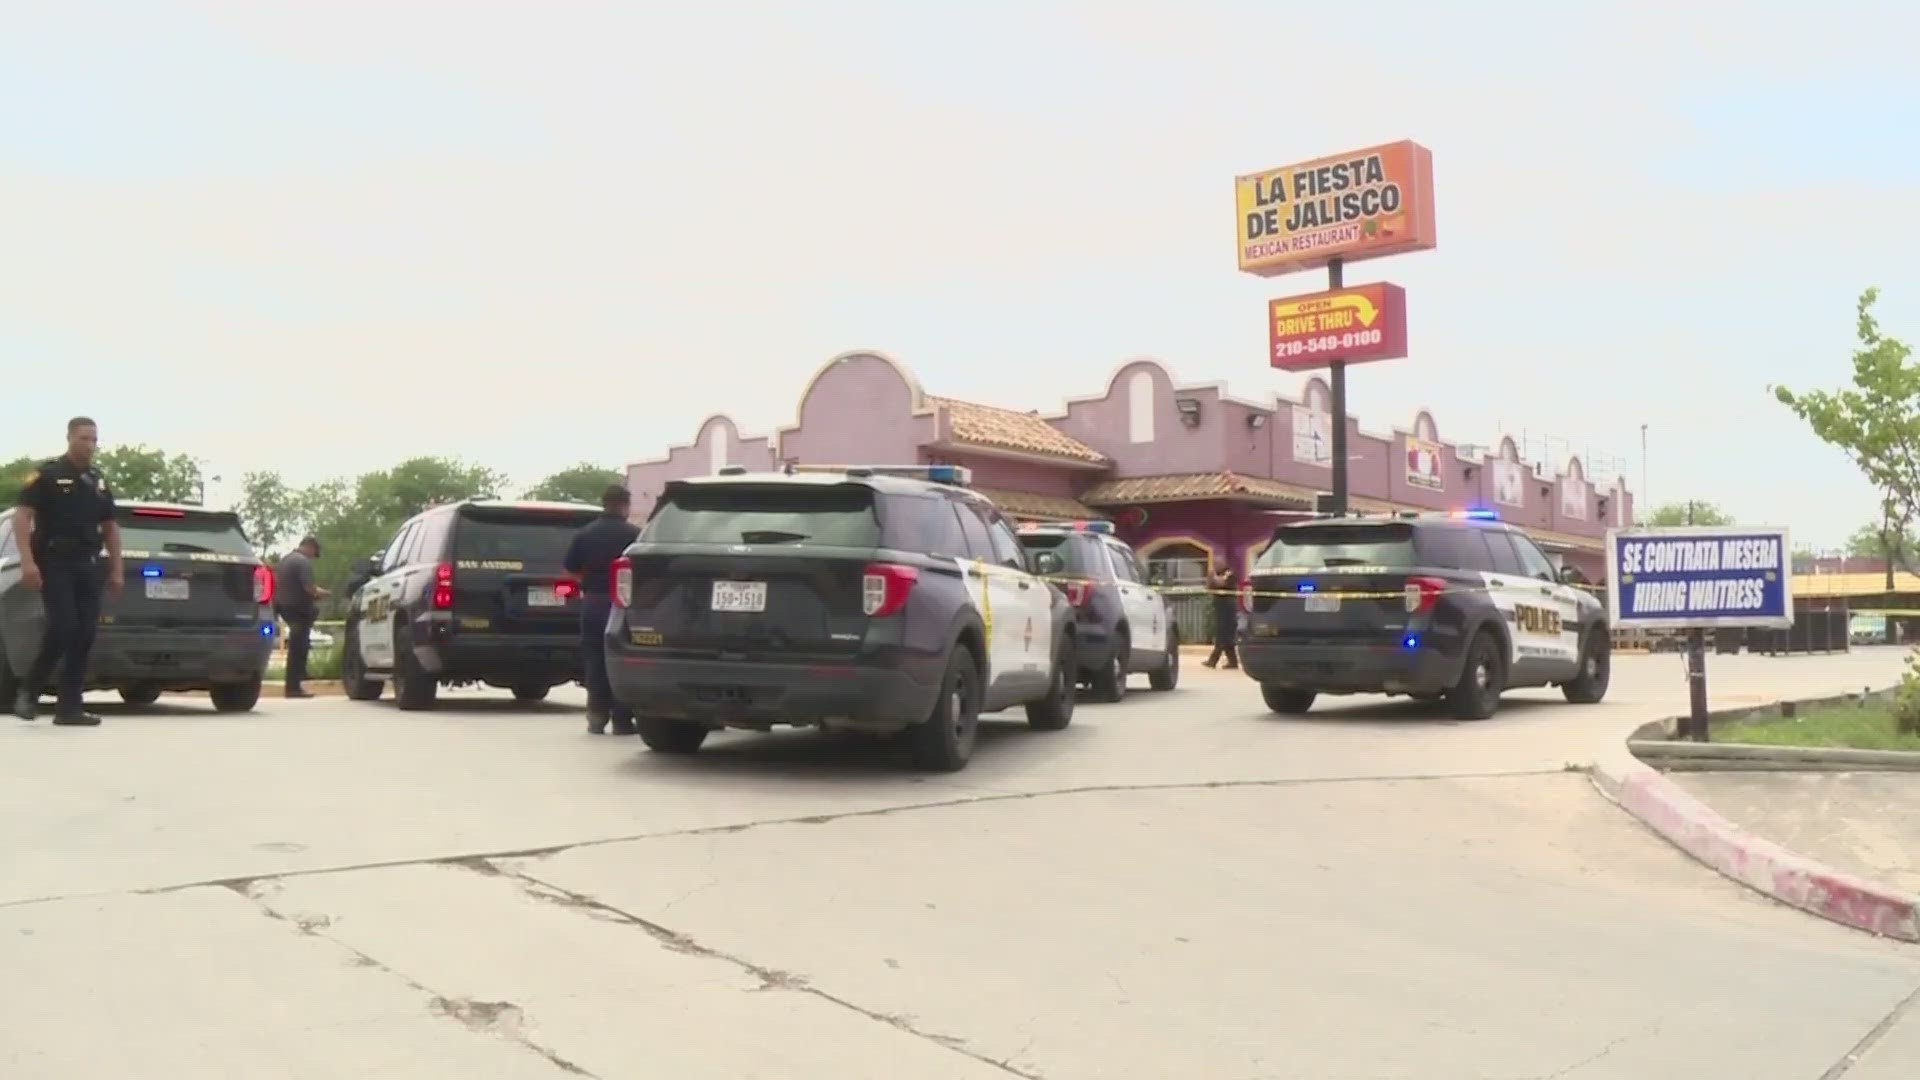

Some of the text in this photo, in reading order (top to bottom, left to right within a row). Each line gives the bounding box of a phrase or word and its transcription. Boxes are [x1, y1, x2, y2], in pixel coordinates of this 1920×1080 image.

[1255, 155, 1384, 207] LA FIESTA
[1247, 184, 1400, 240] DE JALISCO
[1245, 226, 1359, 259] MEXICAN RESTAURANT
[1298, 300, 1332, 311] OPEN
[1277, 310, 1353, 336] DRIVE THRU
[1276, 329, 1382, 357] 210-549-0100
[1623, 539, 1778, 573] SE CONTRATA MESERA
[1633, 578, 1764, 612] HIRING WAITRESS
[1514, 603, 1561, 635] POLICE
